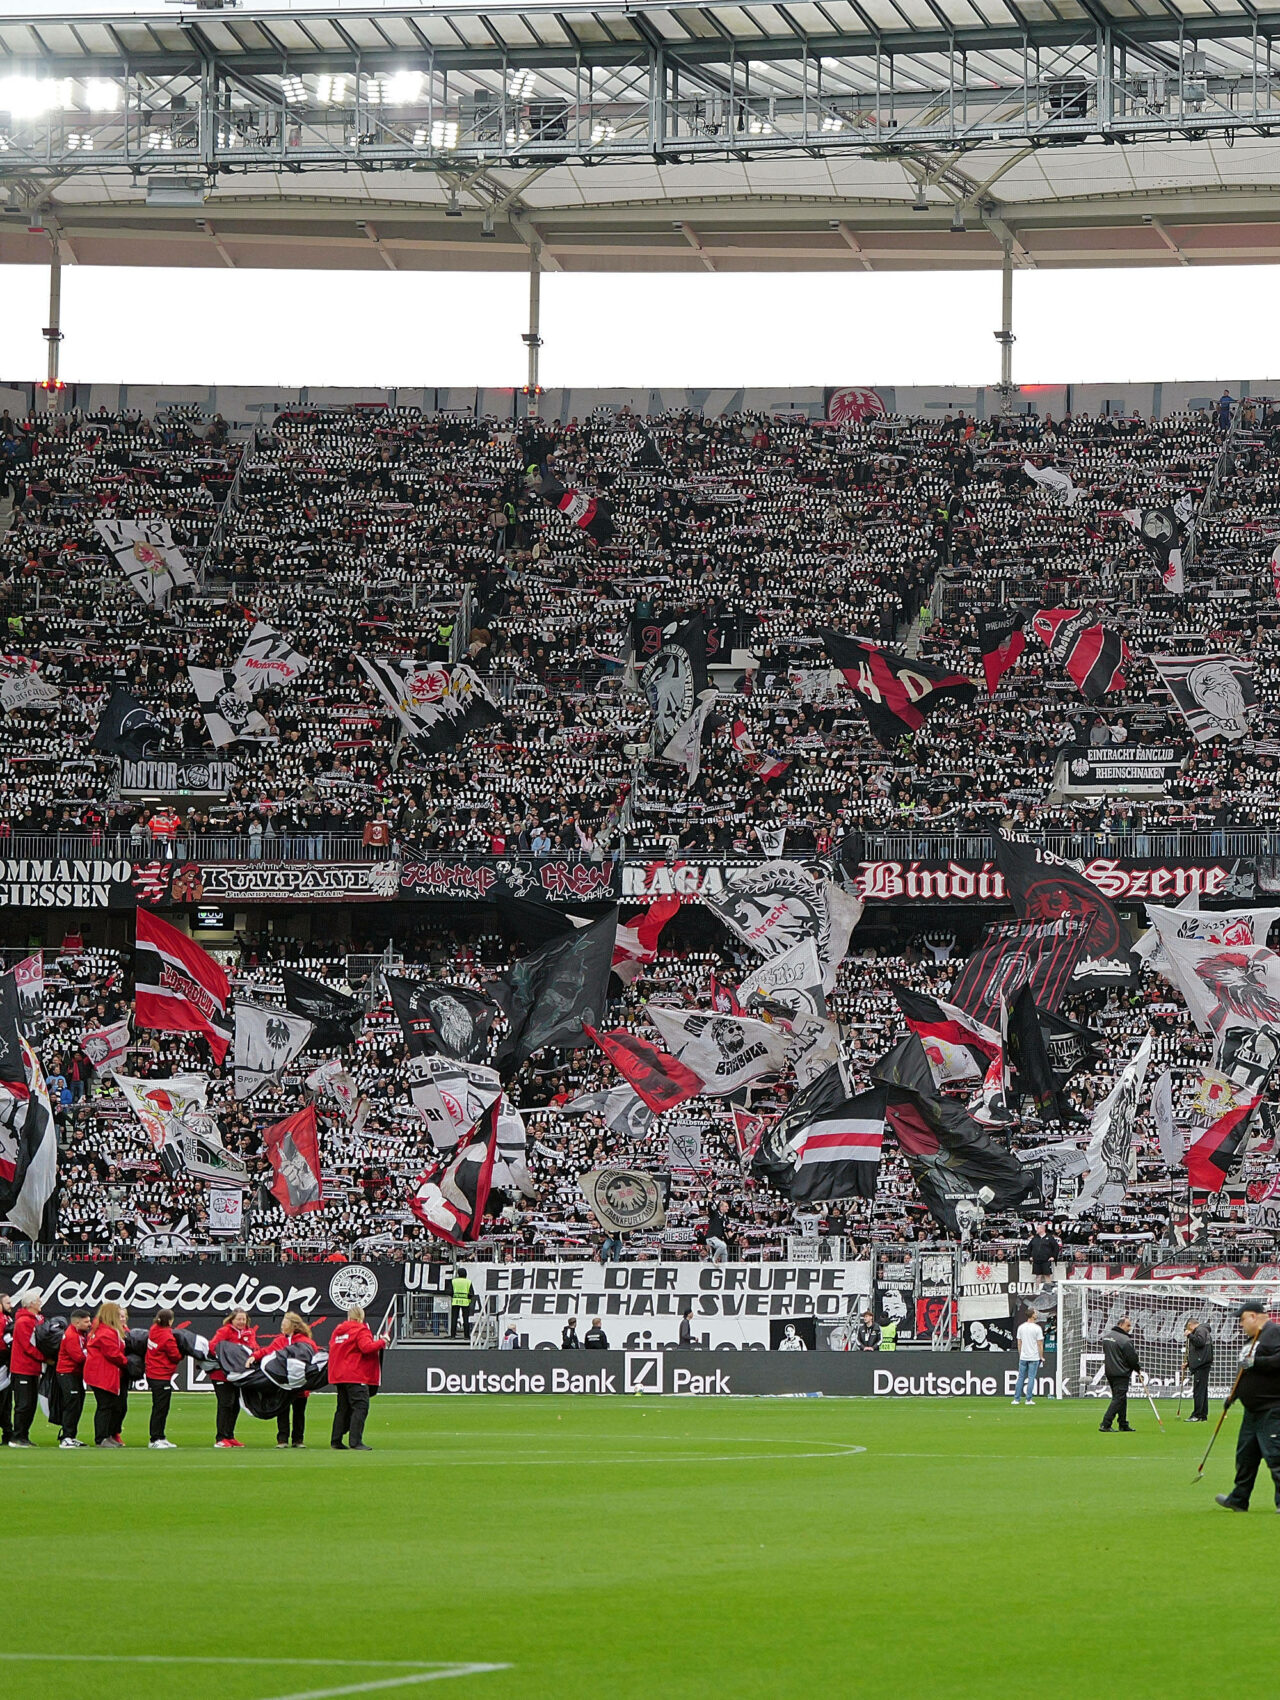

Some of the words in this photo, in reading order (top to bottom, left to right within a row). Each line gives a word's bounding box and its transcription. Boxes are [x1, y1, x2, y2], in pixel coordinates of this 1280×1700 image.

[245, 657, 294, 677] Motorcity
[1087, 749, 1135, 760] EINTRACHT
[1136, 749, 1174, 760] FANCLUB
[122, 760, 178, 790] MOTOR
[1096, 767, 1165, 779] RHEINSCHNAKEN
[202, 867, 370, 893] KUMPANE
[540, 861, 614, 895] CREW
[1082, 859, 1229, 898] Szene
[404, 1262, 454, 1291] ULF
[485, 1267, 584, 1291] EHRE
[603, 1267, 678, 1291] DER
[699, 1268, 846, 1291] GRUPPE
[9, 1269, 321, 1313] Waldstadion
[426, 1367, 545, 1393] Deutsche
[551, 1368, 616, 1393] Bank
[673, 1369, 731, 1394] Park
[873, 1369, 997, 1396] Deutsche
[1004, 1369, 1071, 1396] Bank
